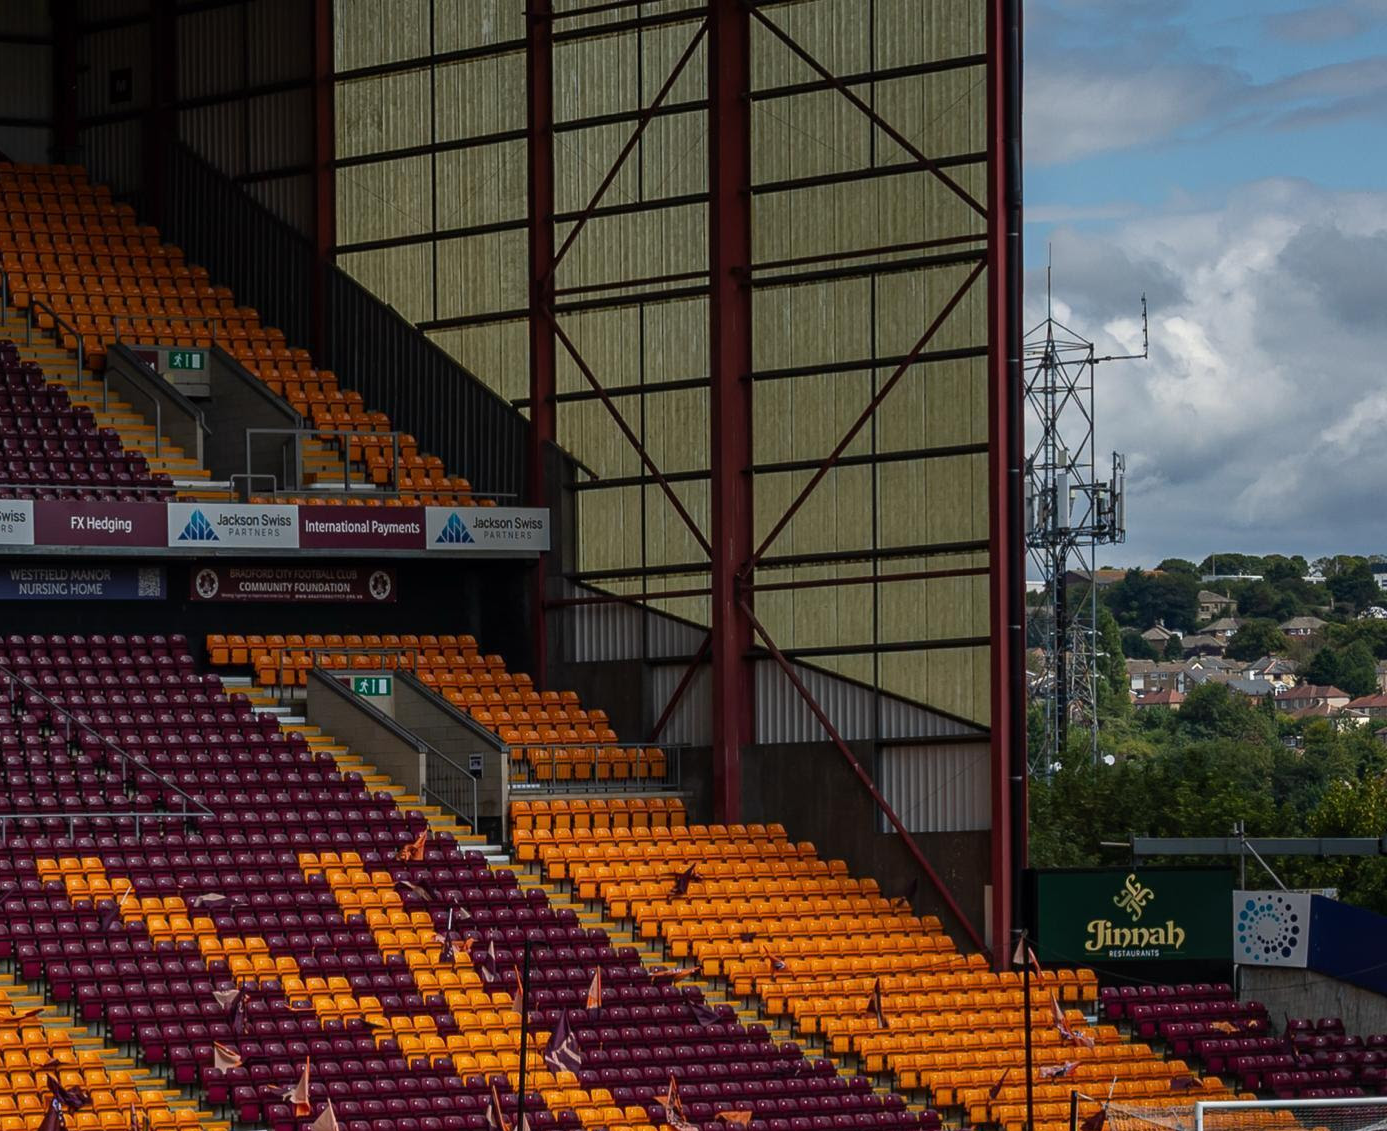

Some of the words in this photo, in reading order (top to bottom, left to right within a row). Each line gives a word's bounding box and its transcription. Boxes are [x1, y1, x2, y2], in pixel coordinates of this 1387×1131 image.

[70, 516, 85, 530] FX
[86, 516, 132, 535] Hedging
[217, 513, 258, 529] Jackson
[260, 514, 292, 527] Swiss
[473, 516, 511, 531] Jackson
[514, 517, 543, 530] Swiss
[228, 528, 280, 537] PARTNERS
[305, 520, 369, 534] International
[371, 520, 421, 537] Payments
[484, 531, 532, 540] PARTNERS
[10, 569, 67, 581] WESTFIELD
[71, 569, 112, 581] MANOR
[229, 568, 275, 579] BRADFORD
[277, 568, 293, 579] CITY
[294, 569, 335, 580] FOOTBALL
[336, 569, 358, 580] CLUB
[19, 583, 68, 595] NURSING
[70, 583, 103, 595] HOME
[239, 582, 292, 592] COMMUNITY
[294, 583, 350, 593] FOUNDATION
[1085, 919, 1185, 951] Jinnah
[1109, 949, 1160, 958] RESTAURANTS
